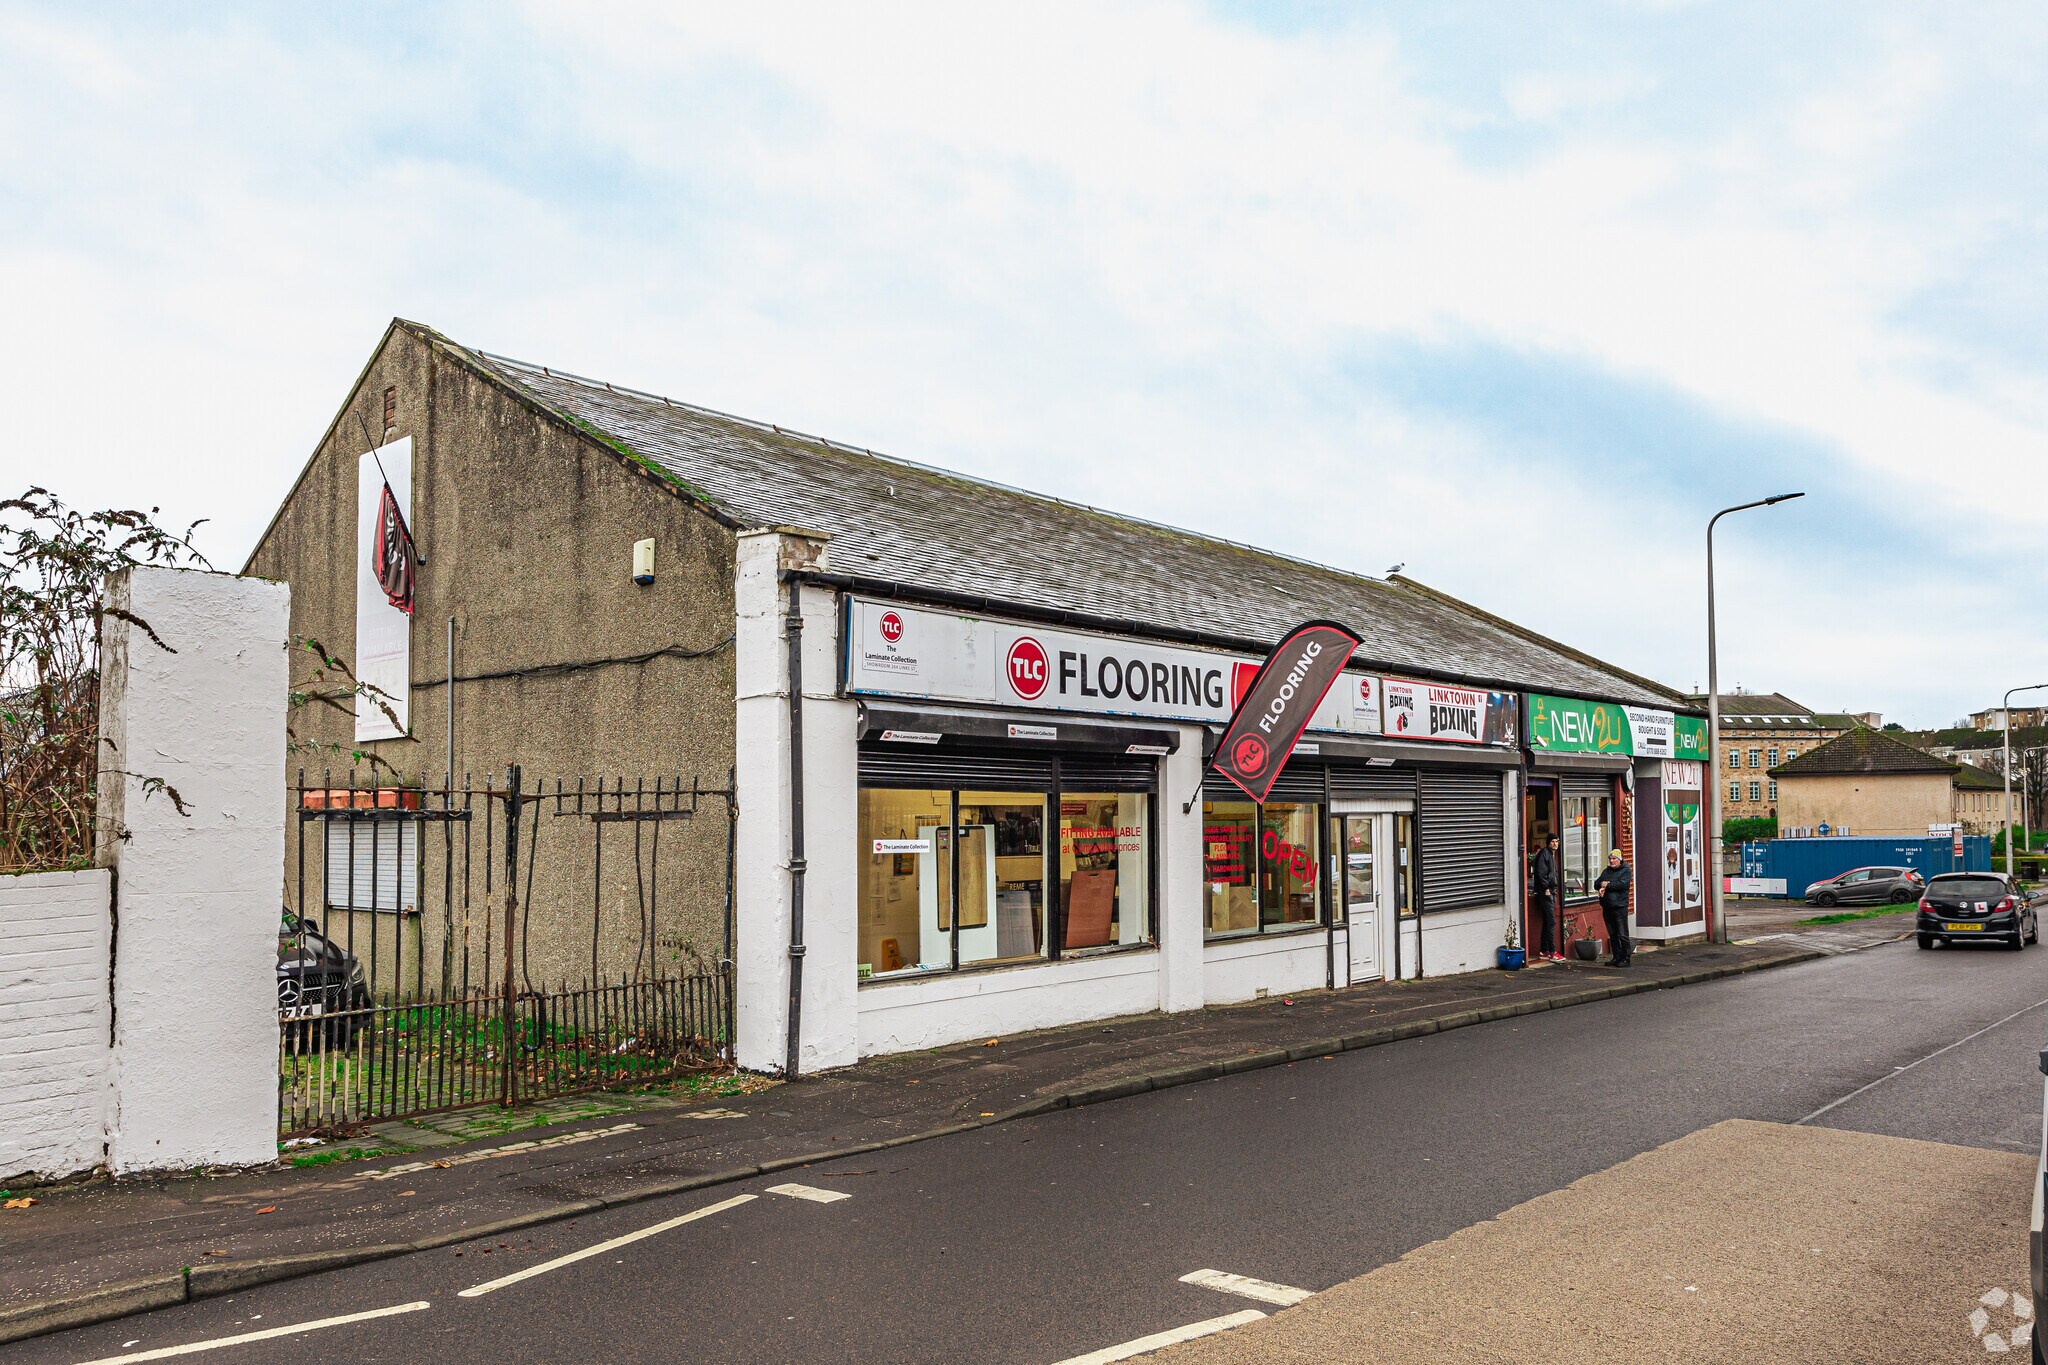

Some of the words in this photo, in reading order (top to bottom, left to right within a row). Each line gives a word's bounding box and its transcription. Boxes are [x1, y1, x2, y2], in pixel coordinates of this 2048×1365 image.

[369, 624, 397, 640] FITTING
[883, 621, 900, 634] TLC
[363, 640, 403, 656] AVAILABLE
[865, 652, 890, 661] Laminate
[891, 655, 917, 665] Collection
[866, 661, 890, 669] SHOWROOM
[1012, 656, 1043, 681] TLC
[1059, 650, 1224, 709] FLOORING
[1259, 640, 1323, 734] FLOORING
[1361, 686, 1369, 694] TLC
[1388, 686, 1412, 694] LINKTOWN
[1428, 688, 1475, 706] LINKTOWN
[1389, 695, 1413, 711] BOXING
[1430, 705, 1477, 739] BOXING
[1629, 713, 1644, 722] SECOND
[1645, 715, 1655, 723] HAND
[1656, 716, 1673, 725] FURNITURE
[1550, 706, 1621, 749] NEW2U
[1638, 725, 1653, 734] BOUGHT
[1657, 727, 1666, 736] SOLD
[1241, 743, 1259, 767] TLC
[1664, 761, 1698, 785] NEW2U
[1060, 827, 1094, 838] FITTING
[1096, 826, 1141, 838] AVAILABLE
[1234, 834, 1253, 842] QUALITY
[1062, 844, 1070, 854] at
[1118, 841, 1140, 854] prices
[1262, 829, 1318, 889] OPEN
